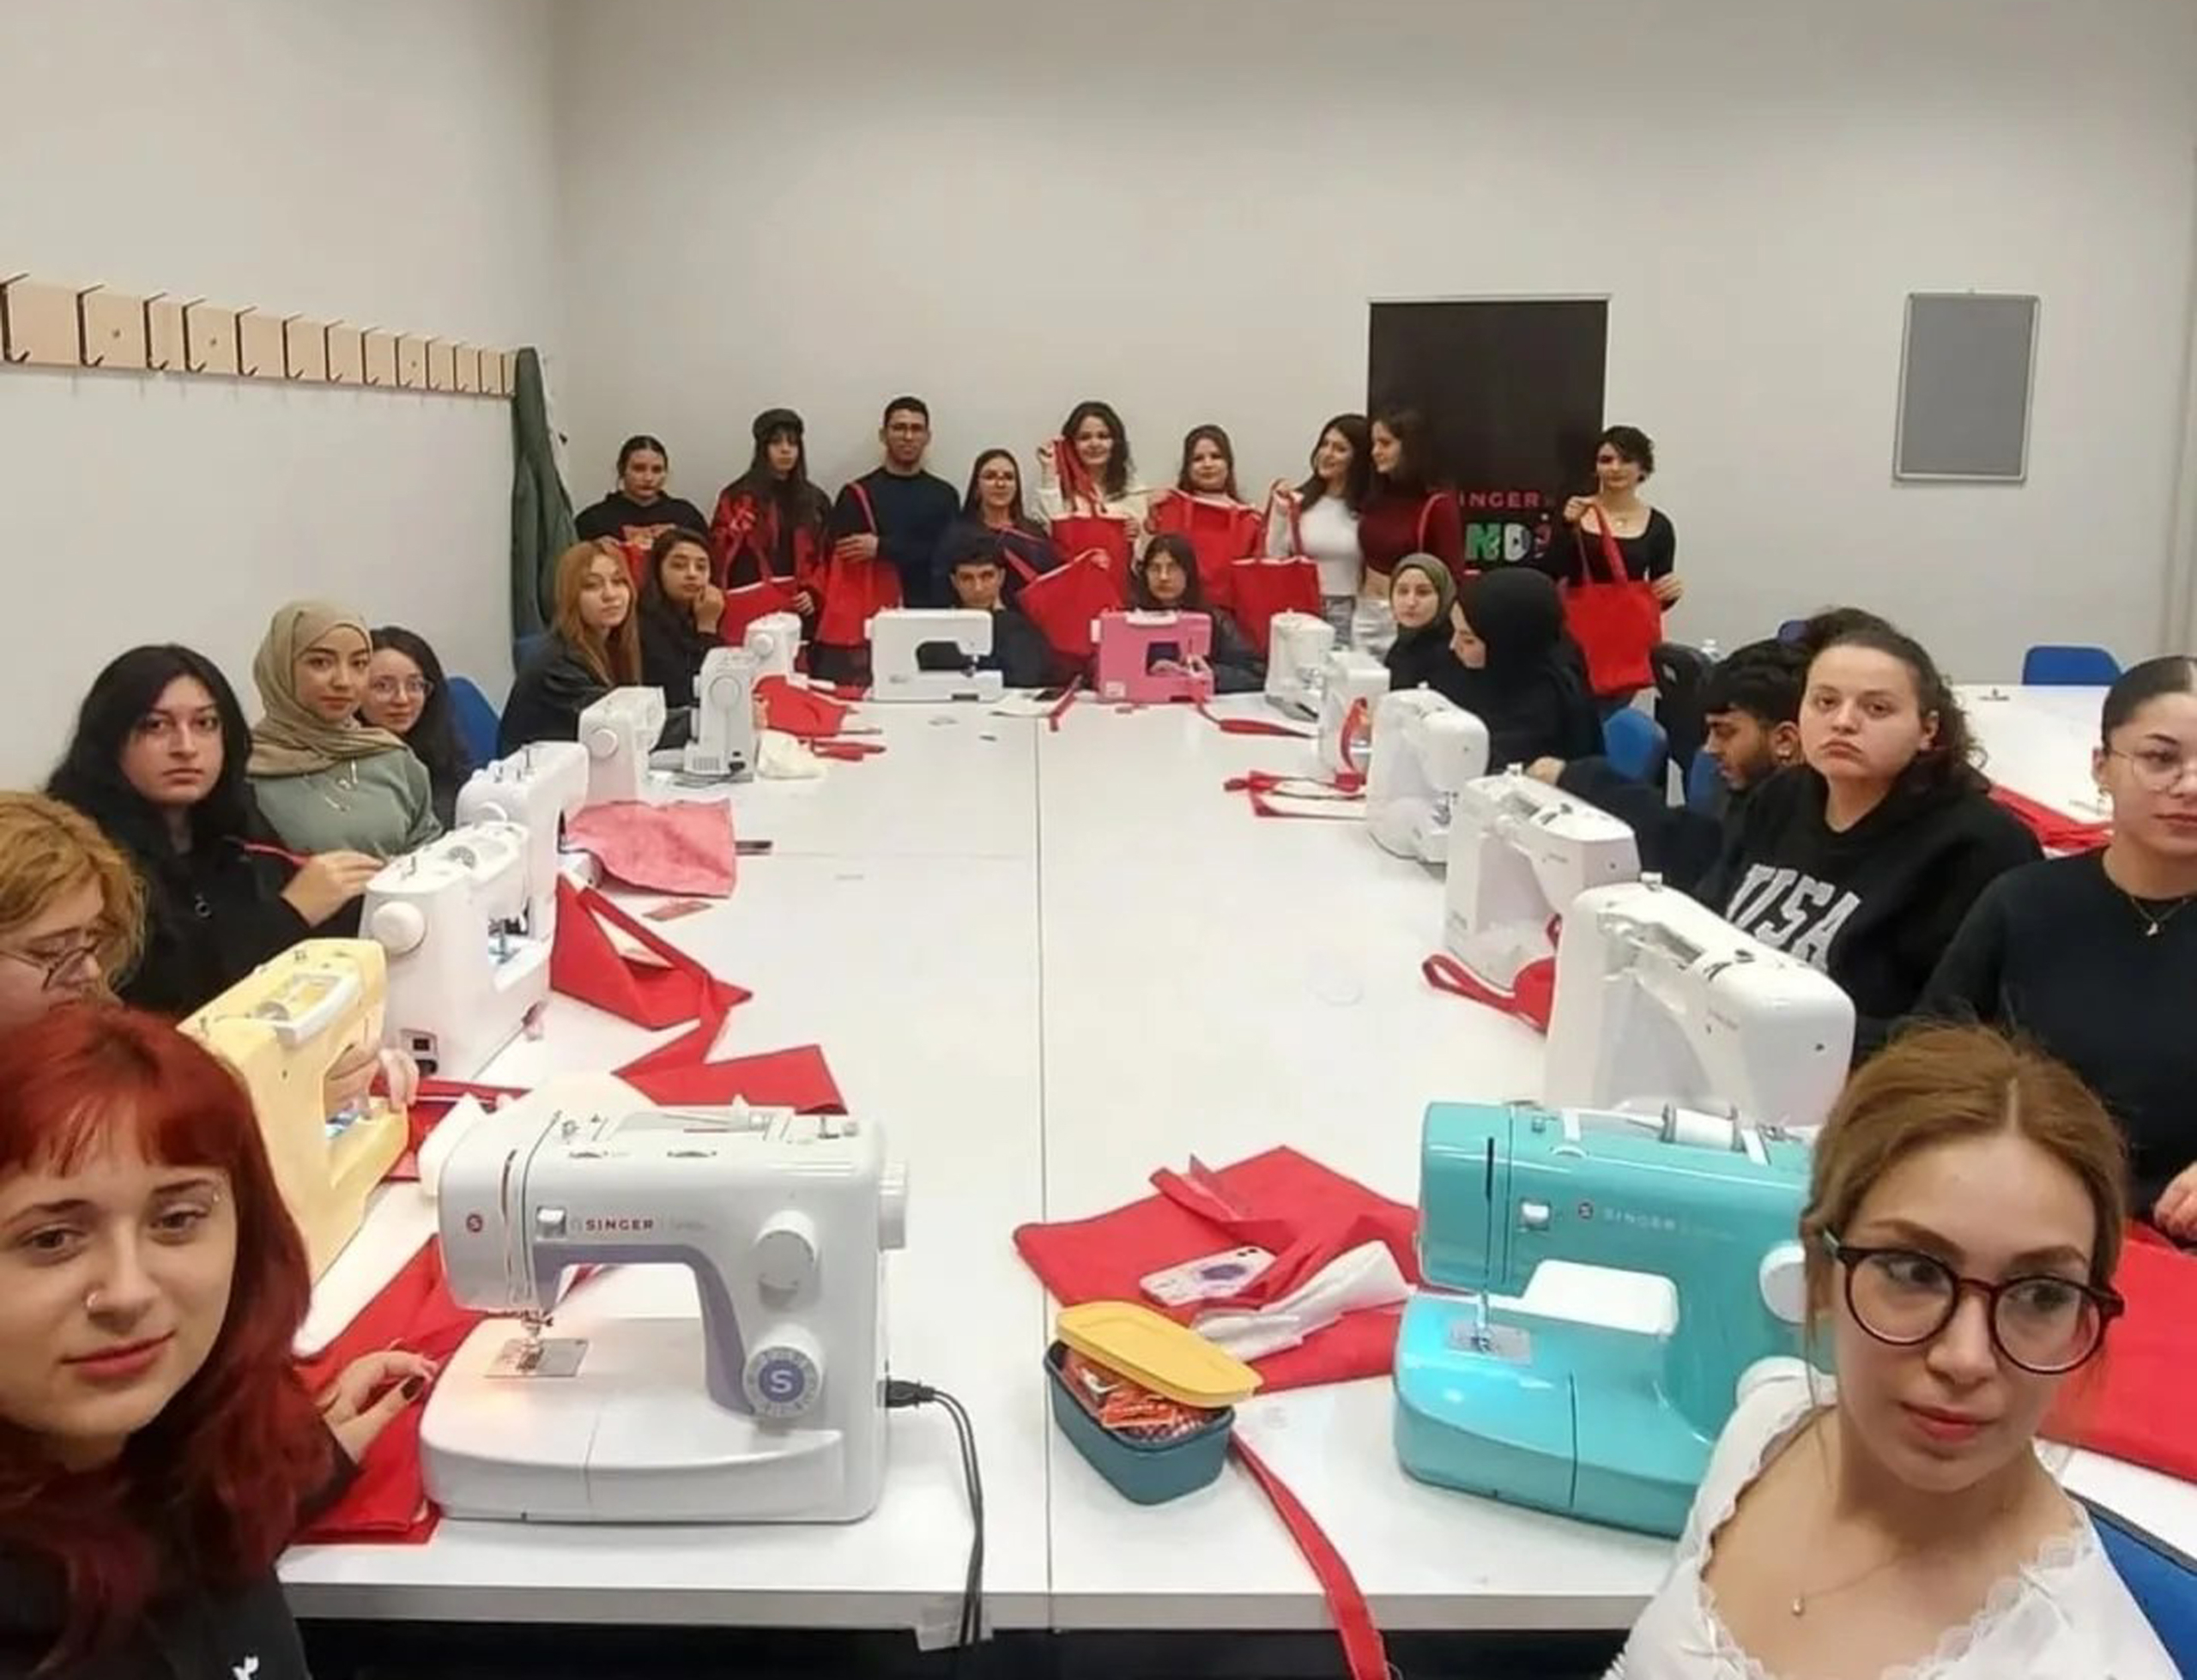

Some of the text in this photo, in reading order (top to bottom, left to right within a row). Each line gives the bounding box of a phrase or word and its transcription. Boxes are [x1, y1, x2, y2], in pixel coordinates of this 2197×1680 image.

[1459, 491, 1540, 508] INGER
[1726, 863, 1861, 974] USA
[585, 1218, 654, 1231] SINGER
[770, 1369, 792, 1393] S
